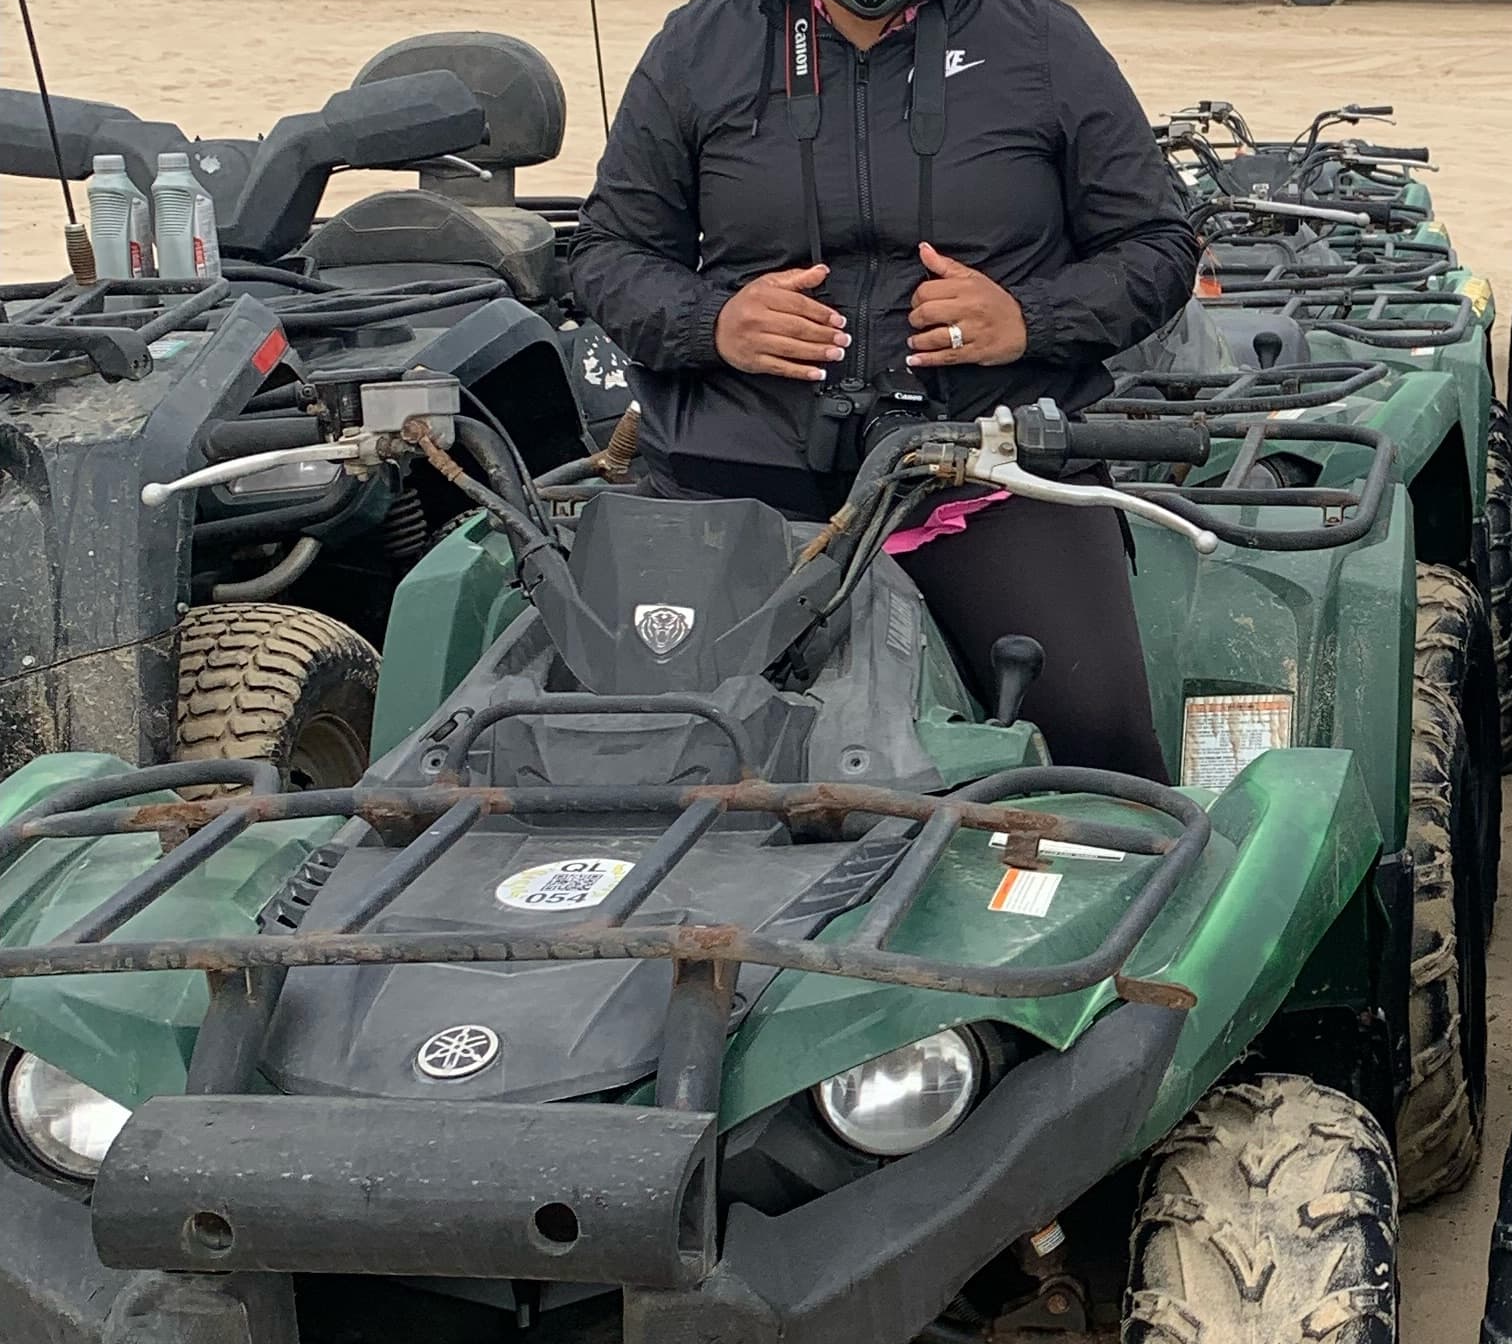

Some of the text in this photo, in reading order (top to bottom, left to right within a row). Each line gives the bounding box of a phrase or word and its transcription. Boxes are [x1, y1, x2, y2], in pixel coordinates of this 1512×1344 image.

[794, 17, 809, 76] Canon
[561, 862, 607, 873] QL
[525, 892, 588, 904] 054
